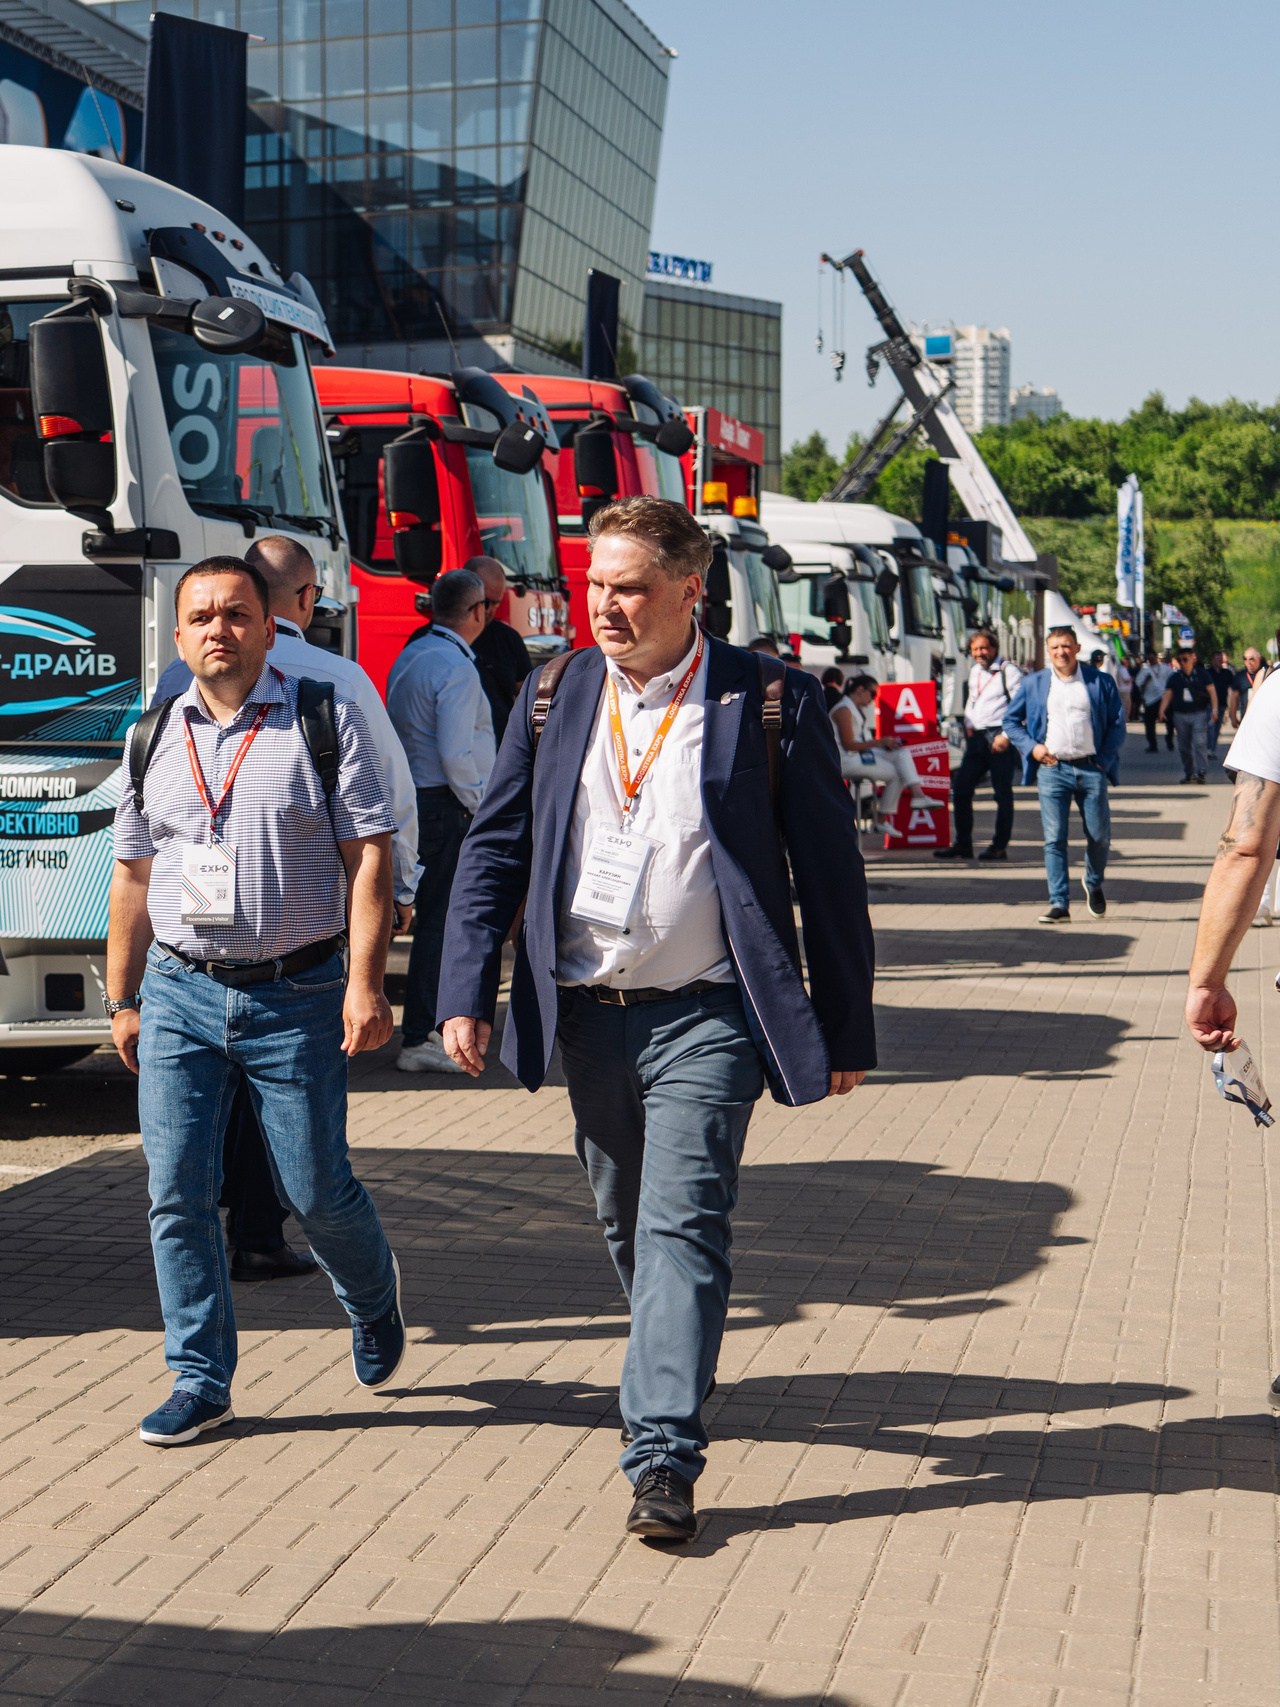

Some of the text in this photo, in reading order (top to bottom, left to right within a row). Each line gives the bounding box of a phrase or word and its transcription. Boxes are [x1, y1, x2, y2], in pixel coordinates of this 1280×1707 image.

[667, 671, 694, 720] LOGISTIKA EXPO
[634, 733, 664, 784] LOGISTIKA EXPO
[607, 835, 633, 848] EXPO
[200, 864, 229, 873] EXPO
